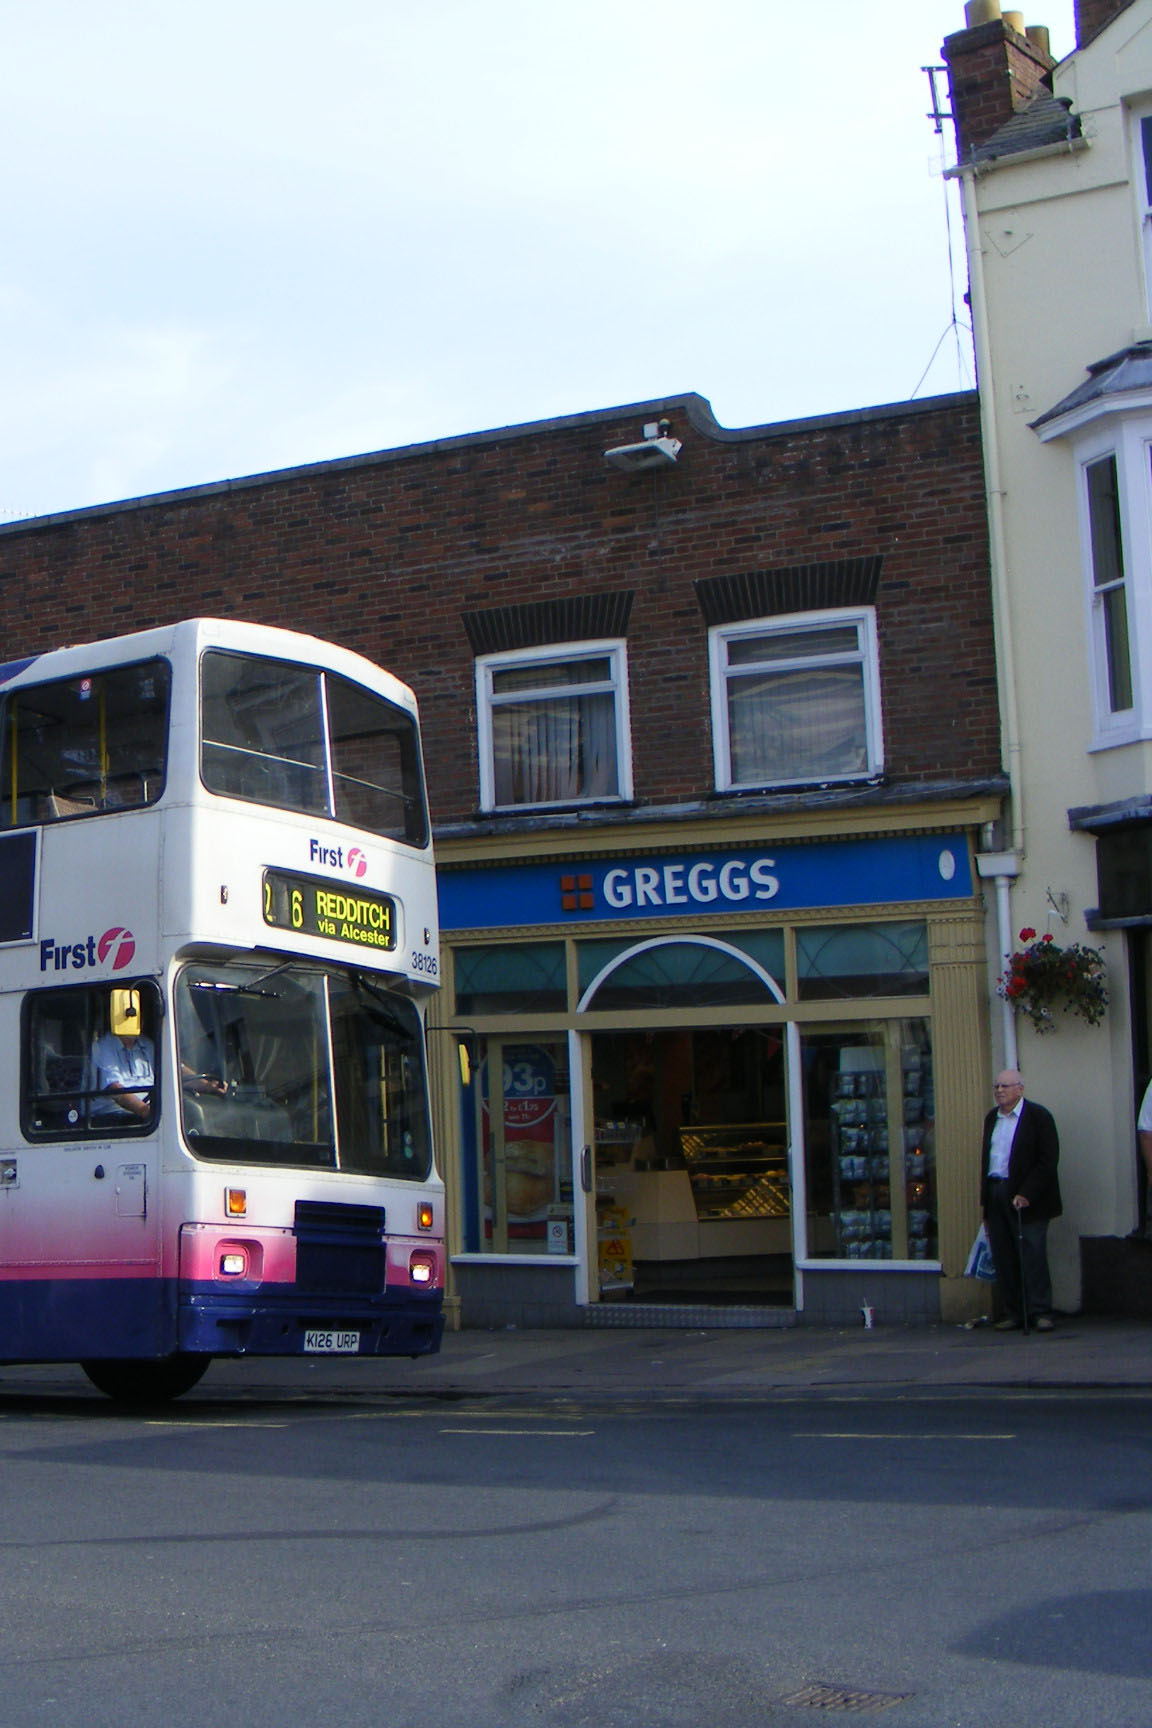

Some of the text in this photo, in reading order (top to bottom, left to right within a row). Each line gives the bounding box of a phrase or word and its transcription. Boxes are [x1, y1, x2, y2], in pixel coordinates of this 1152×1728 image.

[309, 838, 344, 869] First
[603, 858, 780, 909] GREGGS
[291, 889, 304, 928] 6
[316, 890, 390, 931] REDDITCH
[317, 918, 390, 947] via Alcester
[40, 935, 96, 972] First
[411, 951, 438, 975] 38126
[306, 1332, 358, 1348] K126 URP
